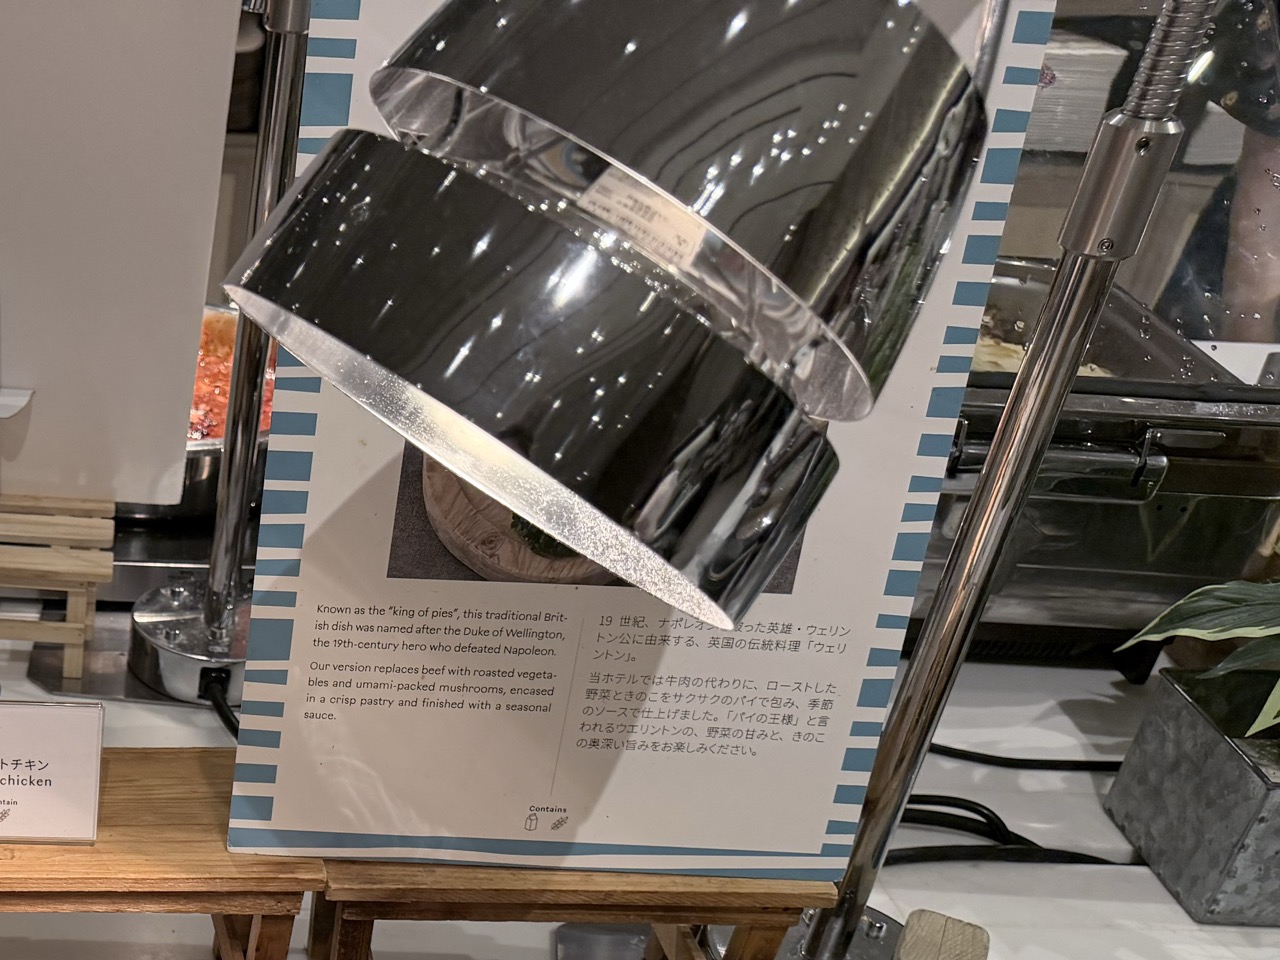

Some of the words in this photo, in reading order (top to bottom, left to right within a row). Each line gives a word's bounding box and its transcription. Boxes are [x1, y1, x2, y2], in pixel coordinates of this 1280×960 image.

[316, 604, 352, 615] Known
[353, 605, 366, 615] as
[367, 604, 386, 616] the
[417, 606, 430, 618] of
[463, 608, 483, 620] this
[485, 610, 542, 622] traditional
[543, 612, 568, 622] Brit-
[314, 619, 330, 631] ish
[331, 620, 354, 632] dish
[355, 624, 375, 633] was
[376, 623, 414, 634] named
[414, 623, 442, 635] after
[443, 625, 462, 636] the
[463, 626, 490, 637] Duke
[491, 626, 504, 637] of
[505, 628, 565, 642] Wellington,
[312, 636, 330, 648] the
[332, 638, 400, 651] 19th-century
[401, 640, 427, 652] hero
[429, 642, 452, 652] who
[453, 642, 502, 654] defeated
[503, 645, 557, 657] Napoleon.
[309, 661, 331, 671] Our
[332, 661, 372, 673] version
[373, 663, 419, 675] replaces
[421, 664, 446, 675] beef
[447, 665, 471, 676] with
[473, 667, 516, 678] roasted
[517, 670, 557, 681] vegeta-
[307, 676, 329, 687] bles
[332, 678, 353, 689] and
[355, 679, 436, 692] umami-packed
[439, 682, 506, 696] mushrooms,
[509, 686, 555, 696] encased
[305, 692, 316, 703] in
[319, 696, 326, 704] a
[329, 694, 358, 707] crisp
[359, 695, 395, 708] pastry
[397, 697, 419, 708] and
[422, 697, 465, 709] finished
[468, 700, 492, 710] with
[495, 703, 502, 711] a
[505, 702, 552, 712] seasonal
[303, 711, 337, 721] sauce.
[0, 775, 52, 787] chicken
[529, 805, 567, 813] Contains
